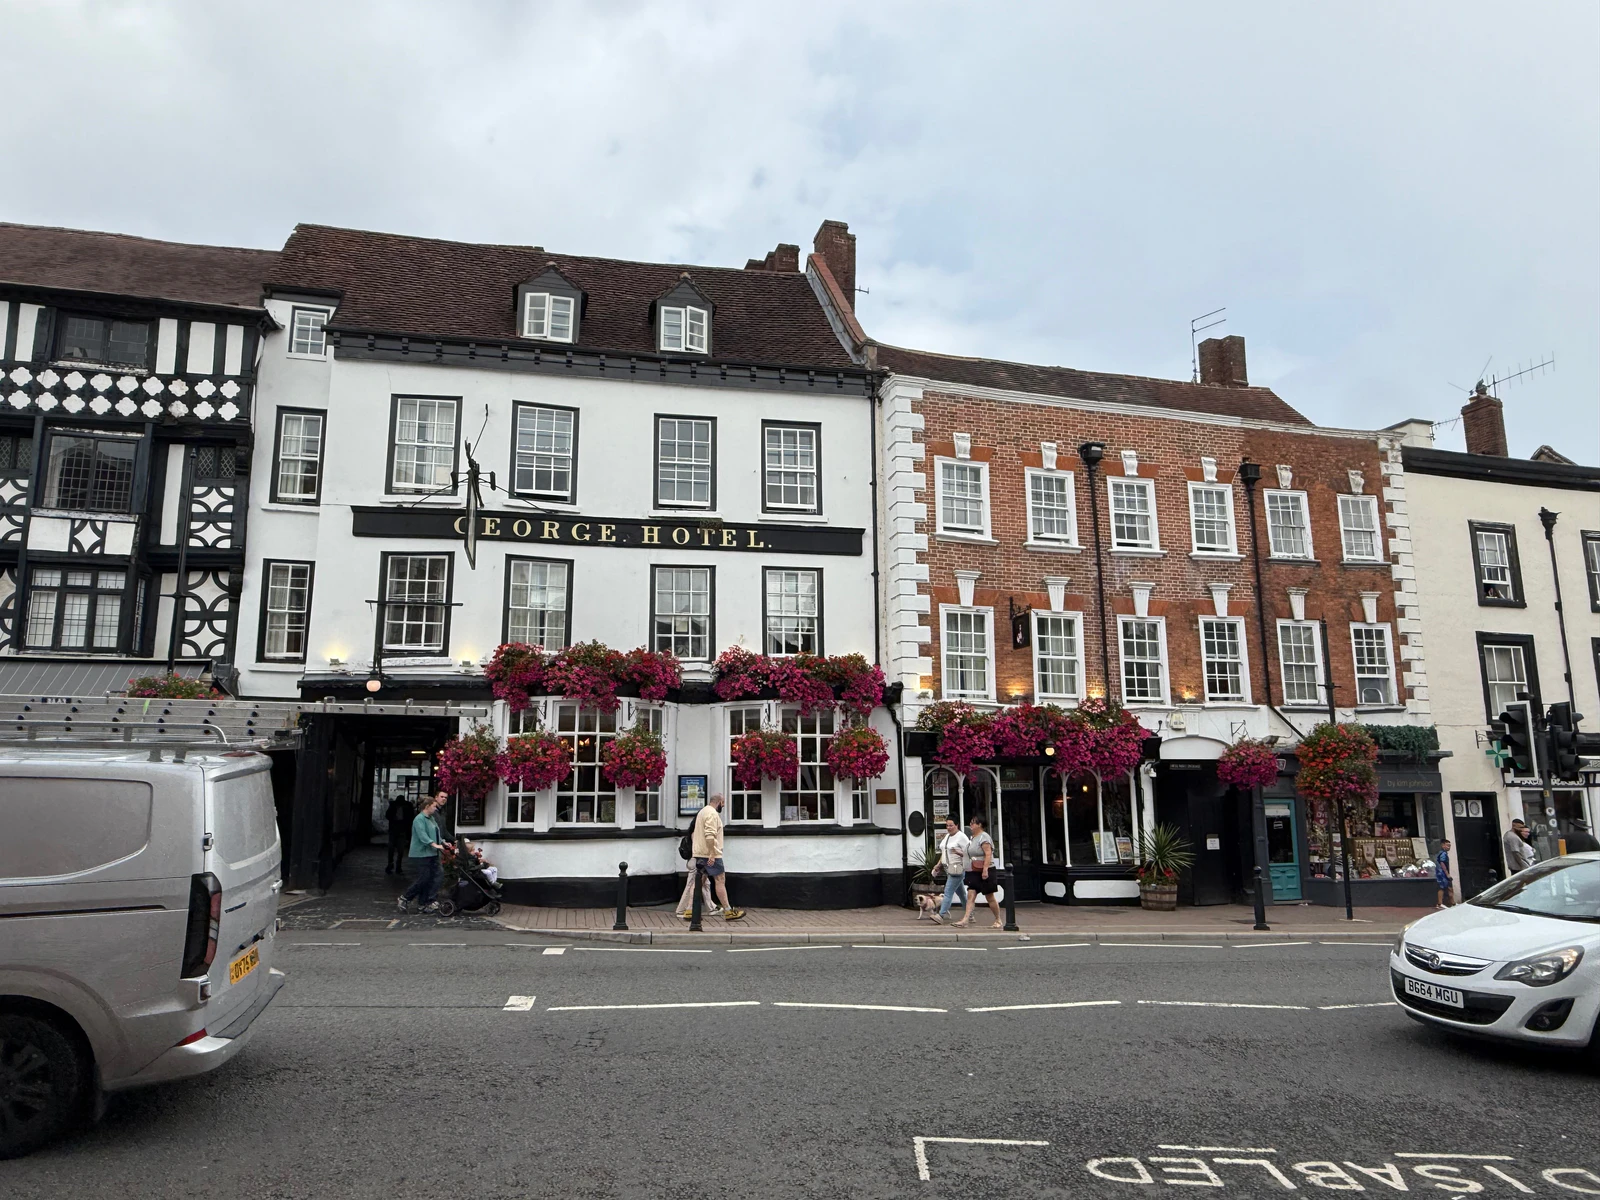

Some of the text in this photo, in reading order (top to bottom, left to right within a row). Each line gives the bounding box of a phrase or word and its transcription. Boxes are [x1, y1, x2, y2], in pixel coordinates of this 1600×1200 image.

[1408, 979, 1459, 1004] BG64 MGU
[1086, 1156, 1600, 1196] DISABLED
